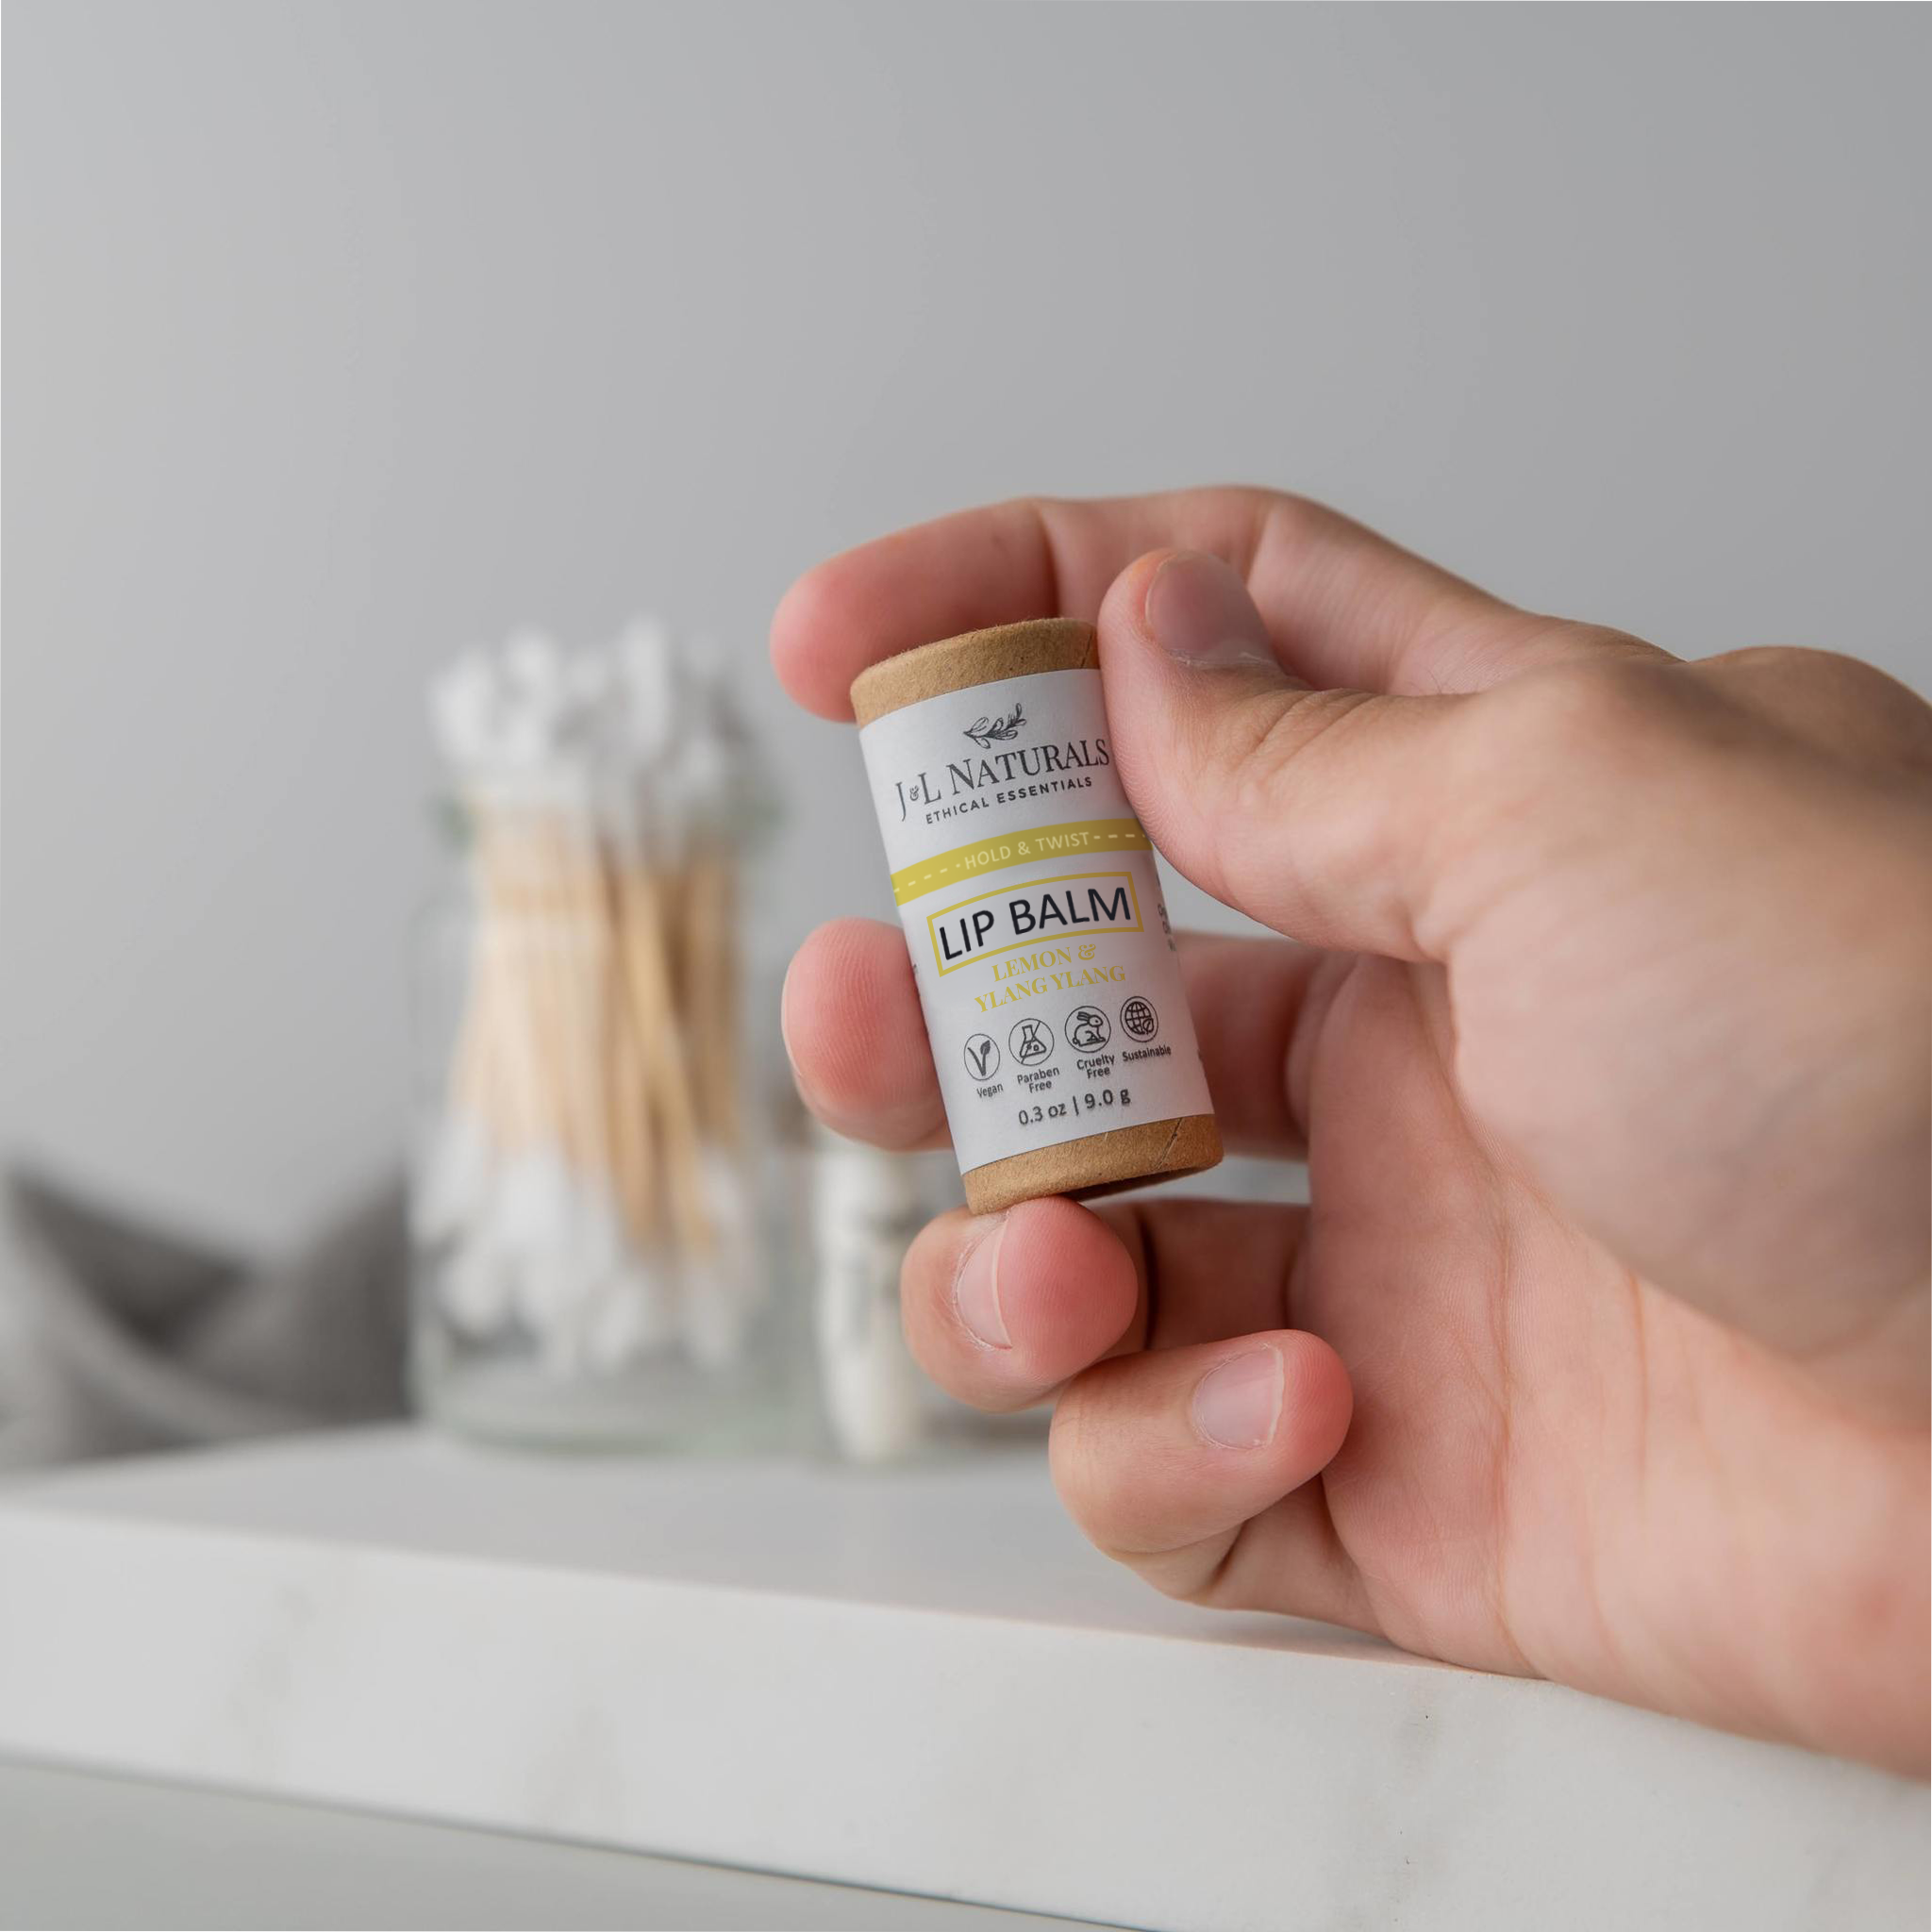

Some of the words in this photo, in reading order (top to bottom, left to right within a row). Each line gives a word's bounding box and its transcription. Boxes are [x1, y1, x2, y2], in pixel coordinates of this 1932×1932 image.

[895, 772, 941, 822] J&L
[946, 739, 1110, 795] NATURALS
[925, 797, 990, 824] ETHICAL
[996, 776, 1092, 804] ESSENTIALS
[964, 846, 1011, 870] HOLD
[1017, 841, 1031, 856] &
[1035, 832, 1090, 852] TWIST
[939, 909, 995, 960] LIP
[1008, 887, 1132, 935] BALM
[991, 946, 1073, 983] LEMON
[1077, 943, 1097, 960] &
[974, 974, 1049, 1014] YLANG
[1050, 965, 1126, 991] YLANG
[1076, 1053, 1115, 1071] Cruelty
[1122, 1044, 1172, 1062] Sustainable
[976, 1082, 1004, 1099] Vegan
[1017, 1066, 1059, 1084] Paraben
[1028, 1079, 1052, 1094] Free
[1086, 1066, 1110, 1079] Free
[1018, 1106, 1043, 1125] 0.3
[1048, 1102, 1067, 1119] oz
[1085, 1089, 1113, 1110] 9.0
[1120, 1089, 1131, 1106] g
